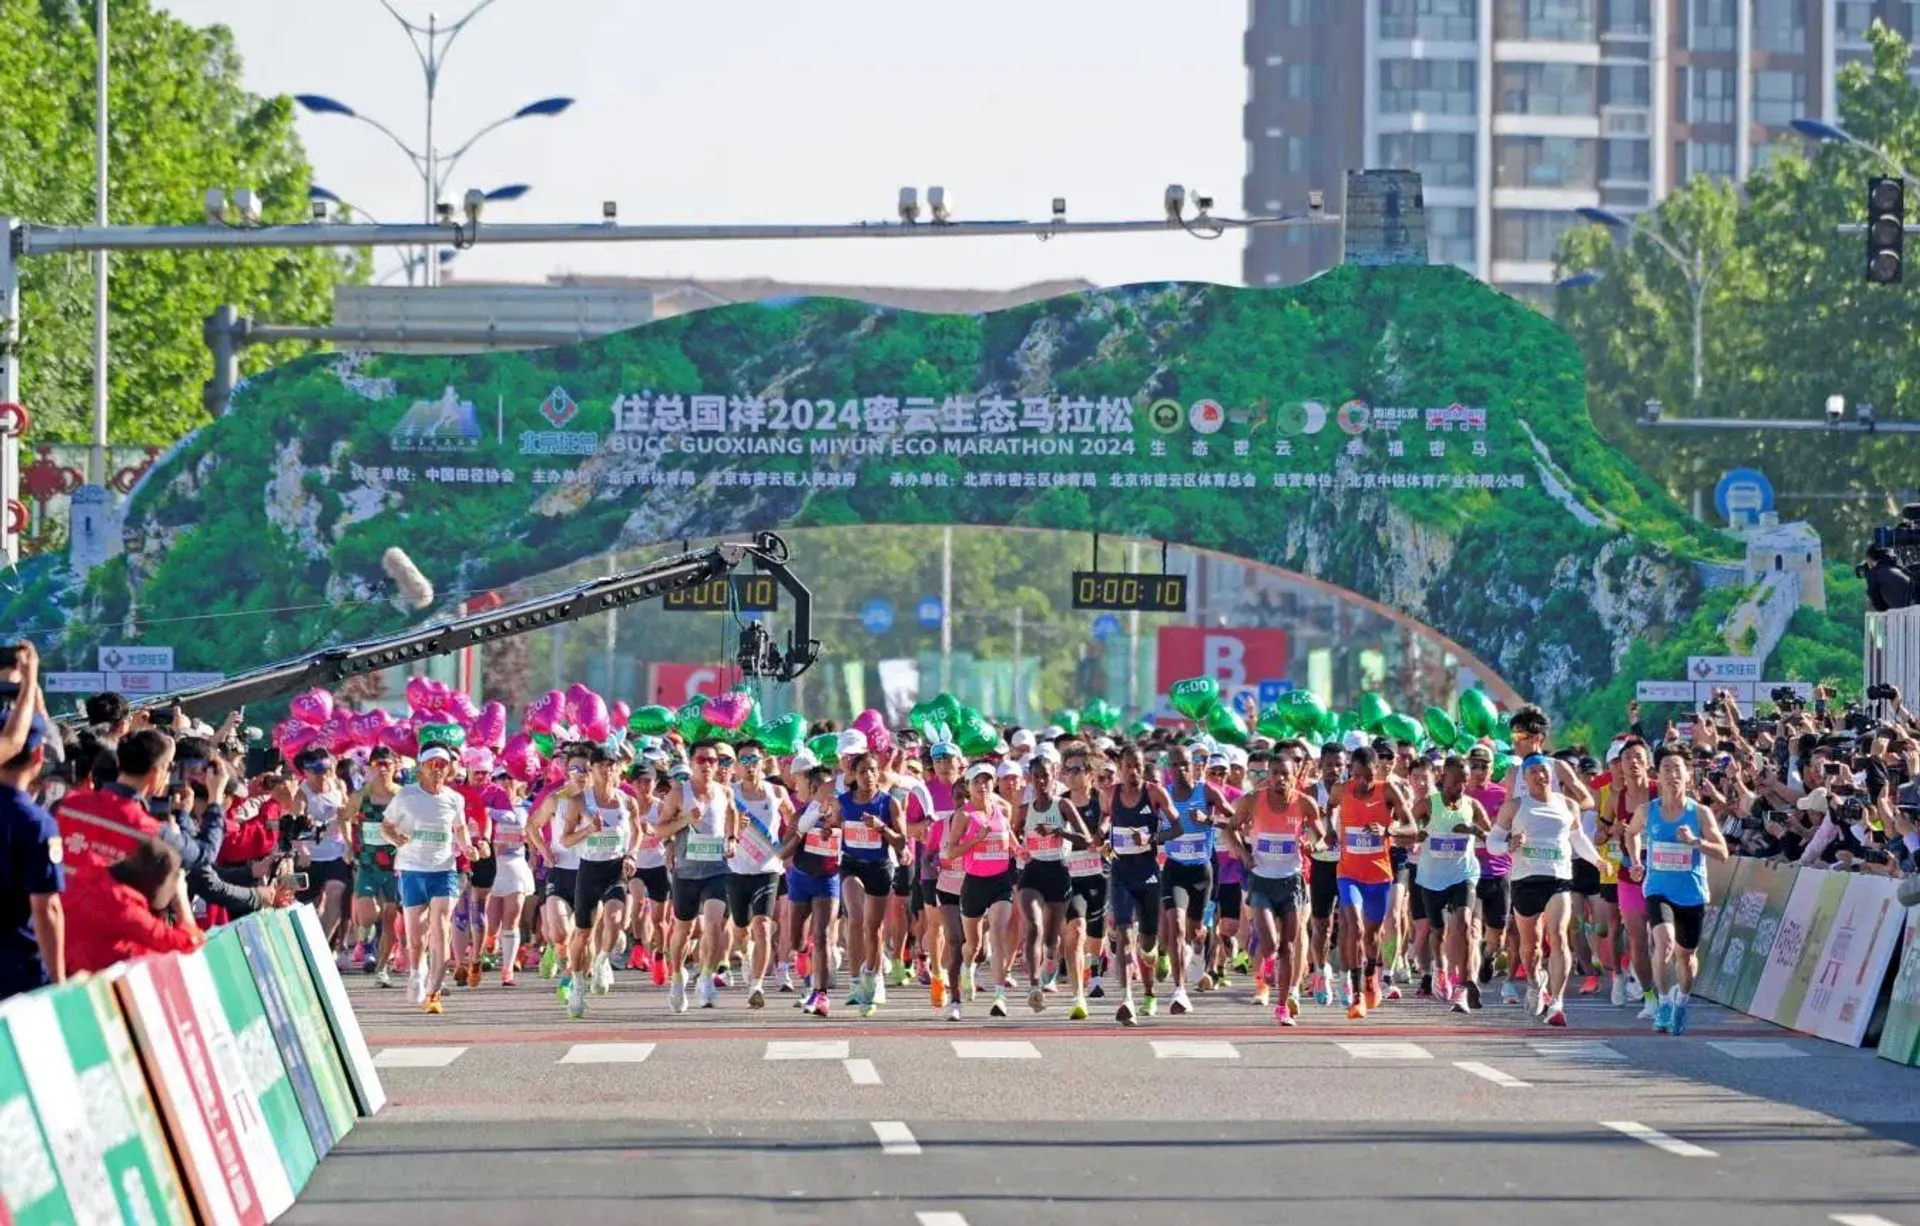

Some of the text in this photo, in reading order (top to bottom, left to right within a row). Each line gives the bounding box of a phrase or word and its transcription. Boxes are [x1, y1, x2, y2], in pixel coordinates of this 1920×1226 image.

[612, 395, 1134, 433] 住总国祥2024密云生态马拉松
[611, 437, 1135, 456] BUCC GUOXIANG MIYUN ECO MARATHON 2024
[1080, 578, 1180, 606] 0:00:10
[1204, 635, 1246, 689] B
[1176, 679, 1209, 694] 4:00
